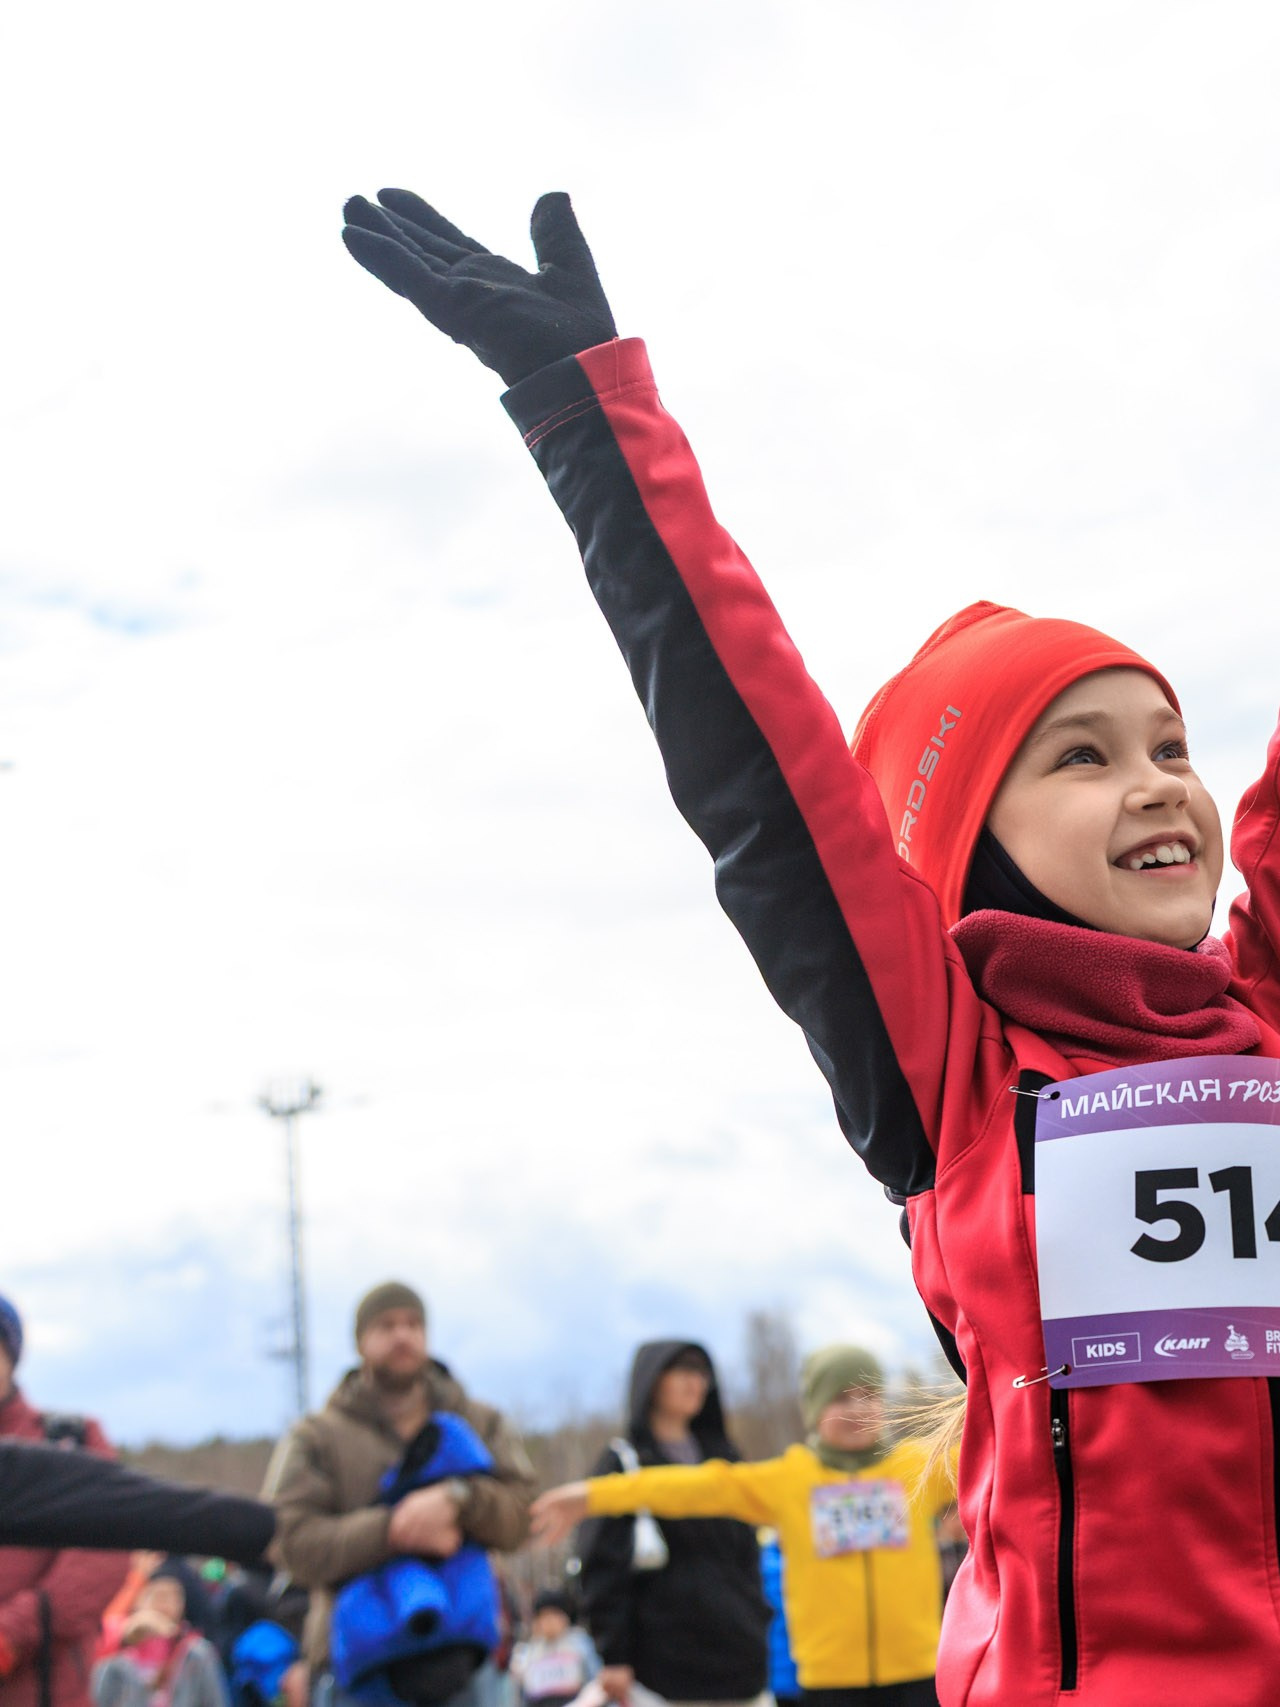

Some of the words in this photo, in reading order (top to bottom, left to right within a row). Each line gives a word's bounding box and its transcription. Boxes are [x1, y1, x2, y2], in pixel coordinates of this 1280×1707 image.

[1061, 1078, 1221, 1119] МАЙСКАЯ
[1086, 1342, 1126, 1358] KIDS
[1163, 1338, 1210, 1351] КАНТ
